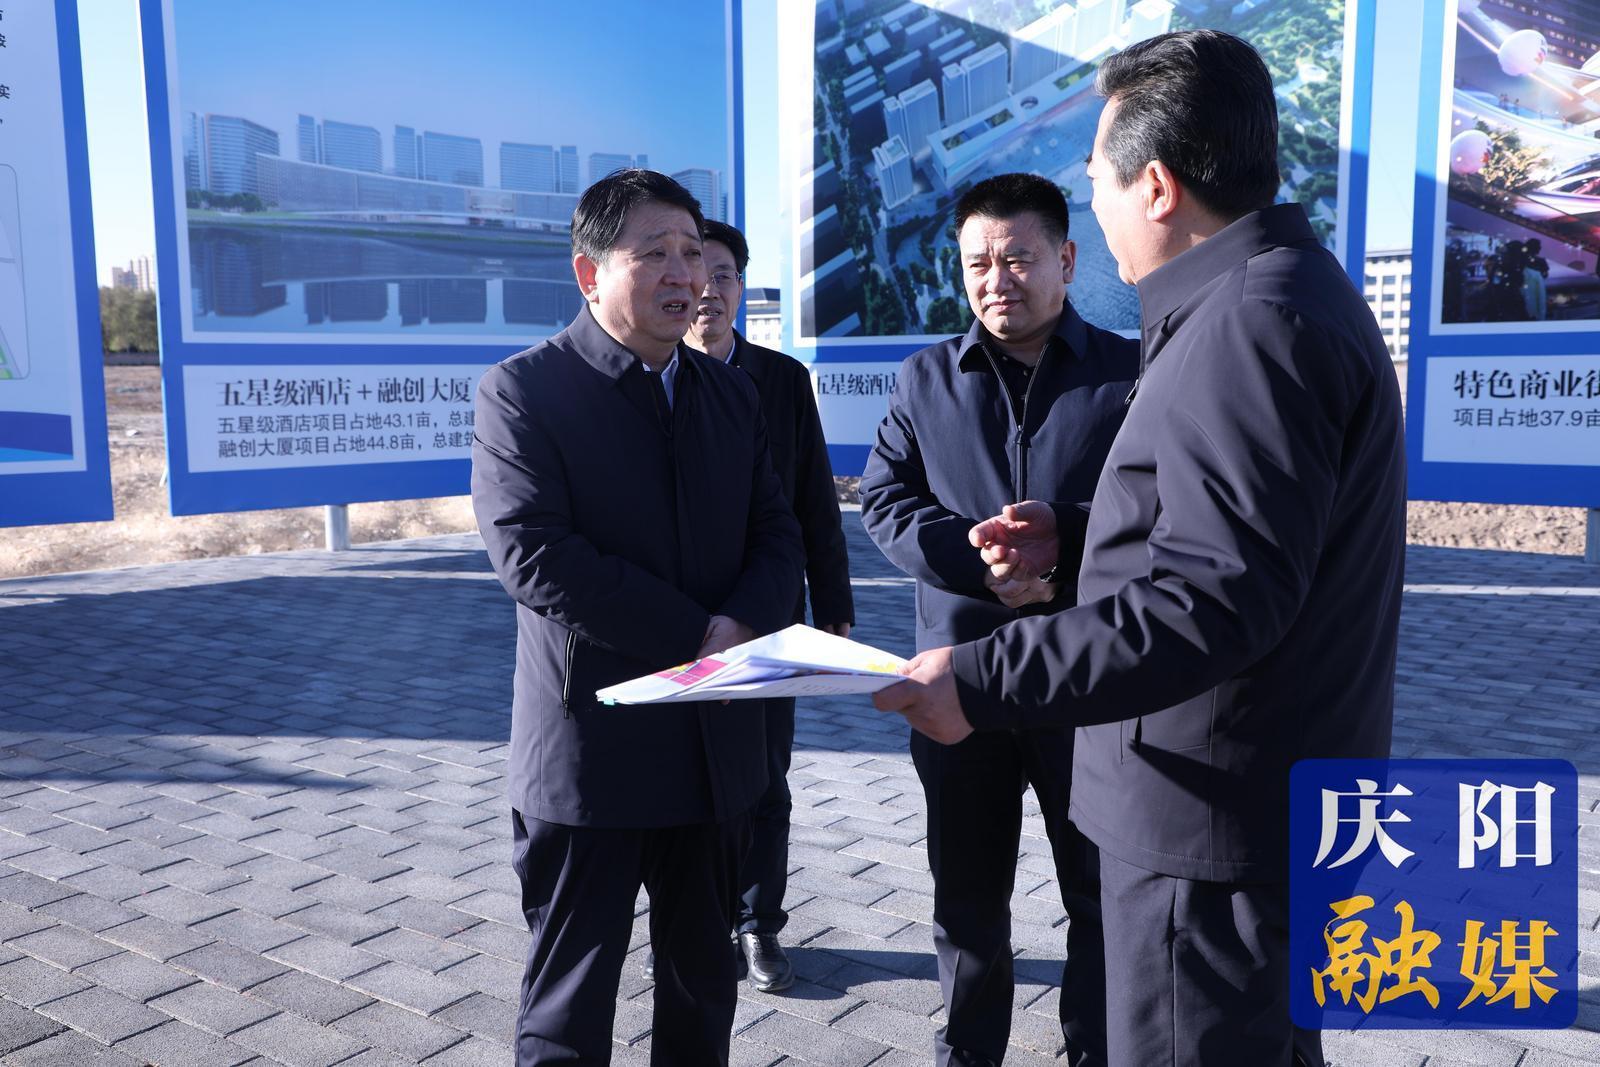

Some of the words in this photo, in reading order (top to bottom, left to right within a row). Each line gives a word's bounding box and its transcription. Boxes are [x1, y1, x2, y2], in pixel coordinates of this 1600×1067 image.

[1453, 408, 1600, 428] 项目占地37.9亩
